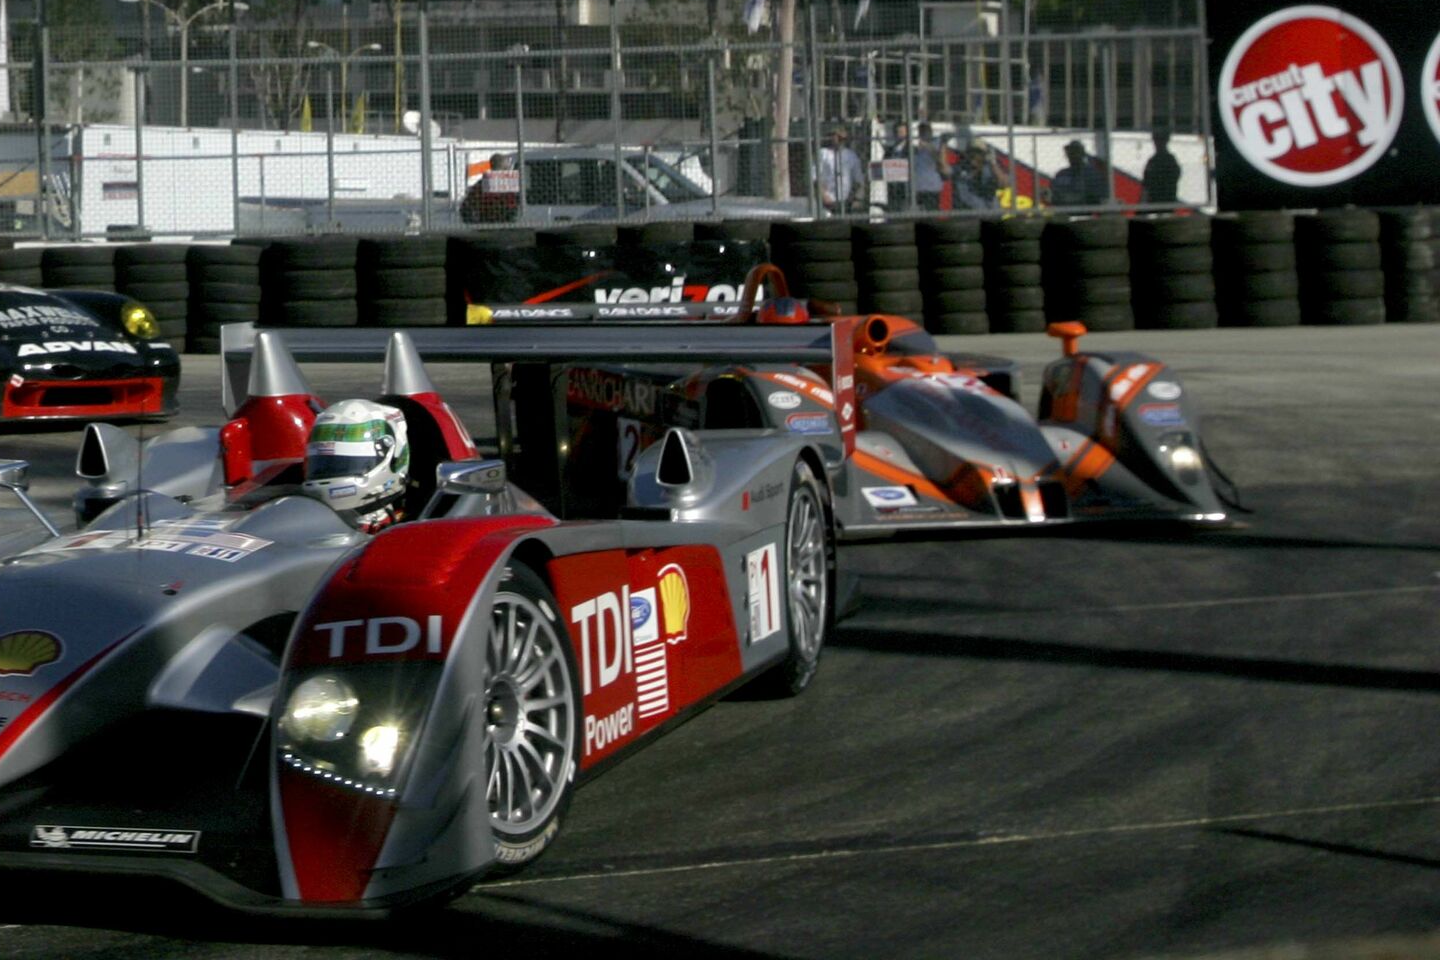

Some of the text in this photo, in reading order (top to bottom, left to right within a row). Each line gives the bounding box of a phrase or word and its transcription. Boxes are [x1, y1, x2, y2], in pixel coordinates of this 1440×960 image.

[1232, 63, 1304, 107] circuit
[1240, 59, 1386, 160] city
[17, 341, 137, 357] ADVAN
[761, 548, 773, 631] 1
[314, 615, 443, 658] TDI
[571, 584, 632, 696] TDI
[585, 702, 634, 756] Power
[71, 830, 193, 844] MICHELIN
